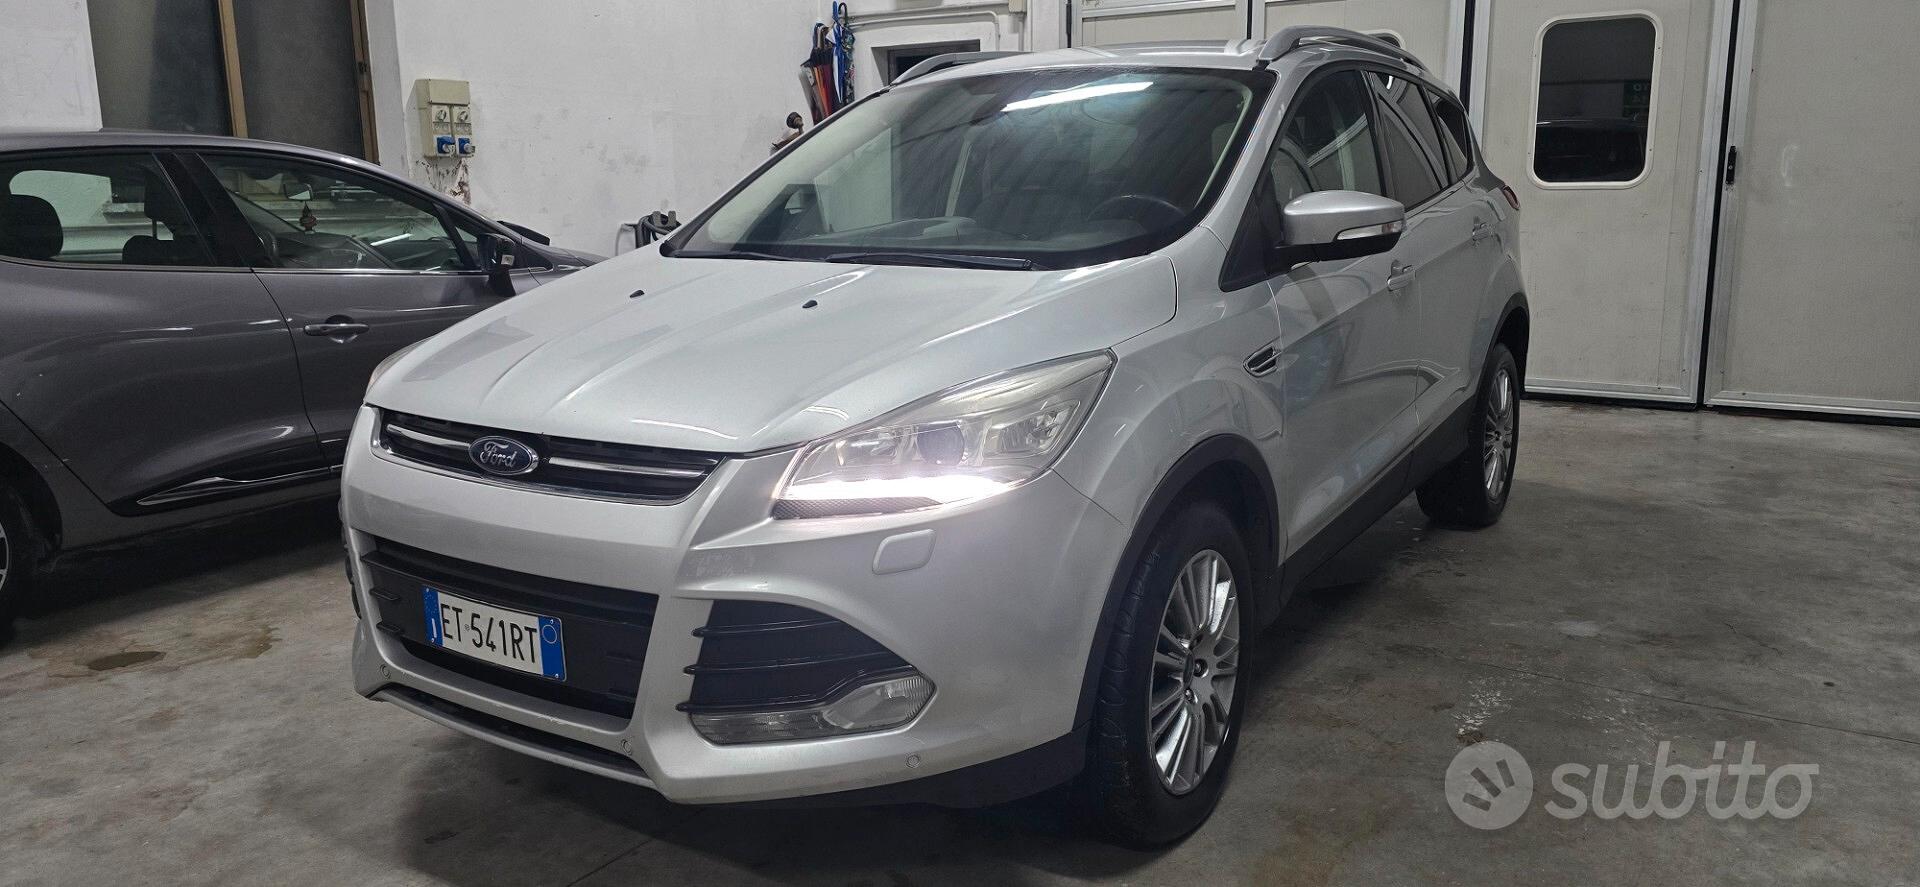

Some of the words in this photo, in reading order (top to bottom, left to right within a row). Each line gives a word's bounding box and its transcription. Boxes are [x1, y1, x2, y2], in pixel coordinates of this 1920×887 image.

[479, 441, 518, 468] Ford
[440, 603, 463, 642] ET
[470, 612, 538, 664] 541RT
